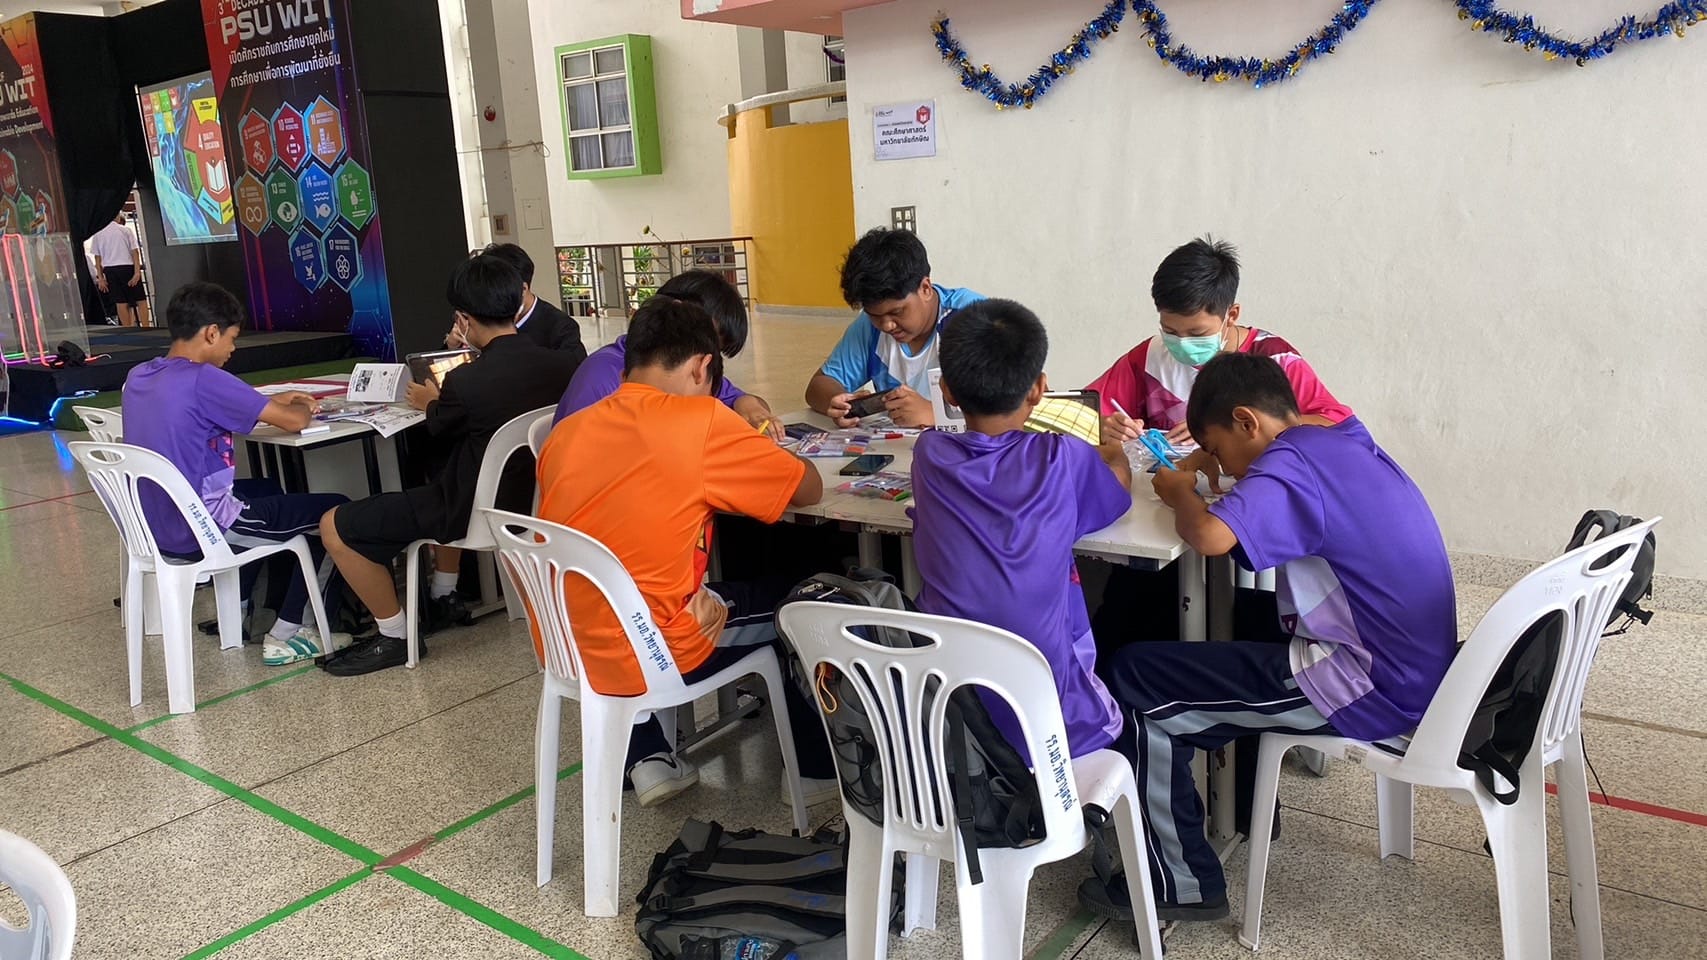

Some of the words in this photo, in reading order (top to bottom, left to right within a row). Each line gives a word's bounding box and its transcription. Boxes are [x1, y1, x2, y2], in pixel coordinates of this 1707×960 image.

[220, 4, 273, 45] PSU
[228, 23, 335, 65] เปิดศักราชกับการศึกษายุคใหม่
[230, 49, 341, 88] การศึกษาเพื่อการพัฒนาที่ยั่งยืน
[4, 75, 35, 104] WIT
[879, 135, 930, 146] มหาวิทยาลัยทักษิณ
[881, 125, 927, 136] คณะศึกษาศาสตร์
[631, 611, 674, 672] รร.มอ.วิทยานุสรณ์
[1045, 733, 1078, 813] รร.มอ.วิทยานุสรณ์
